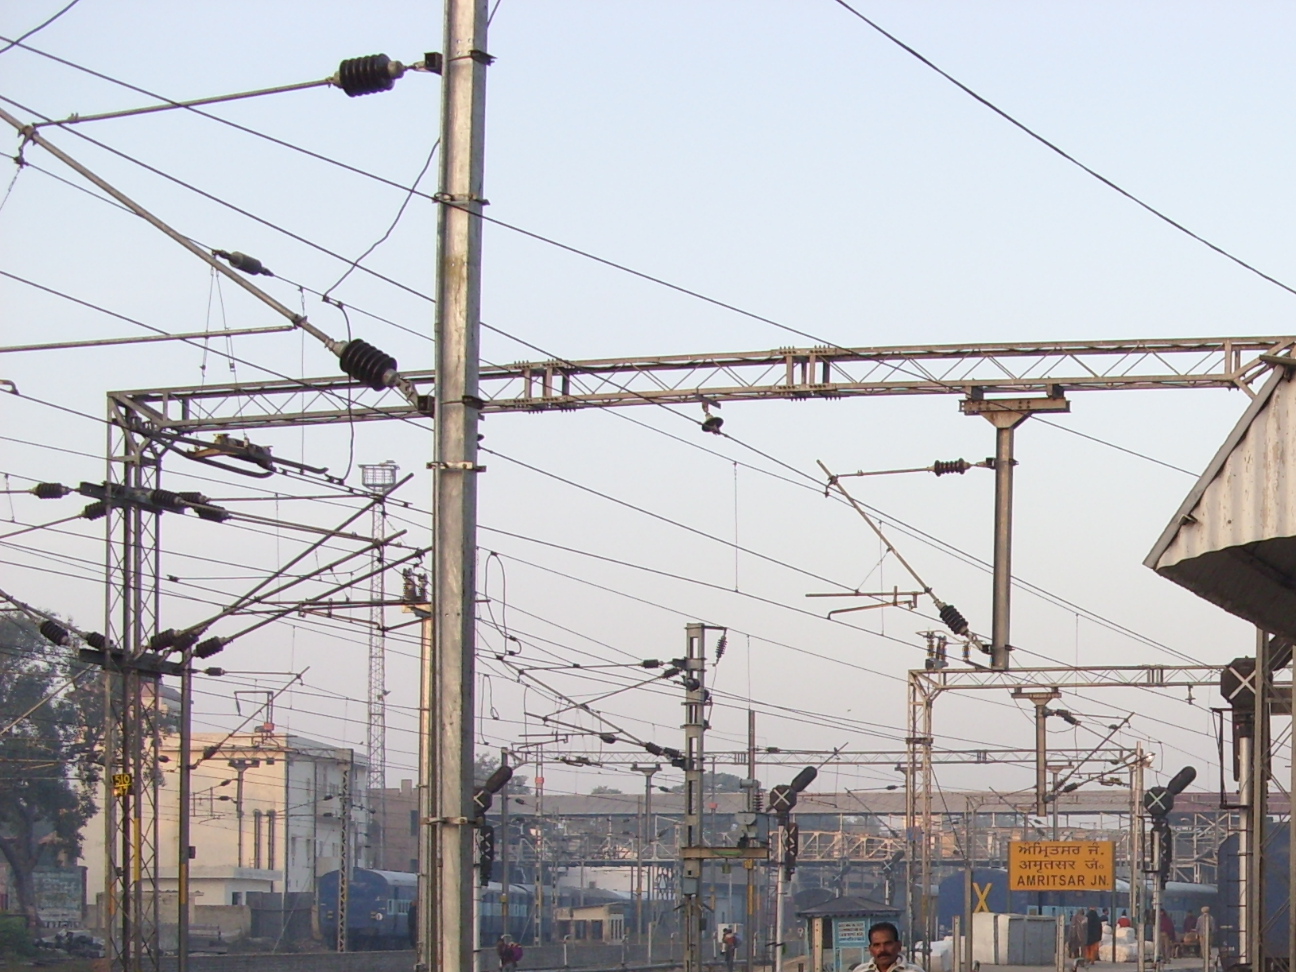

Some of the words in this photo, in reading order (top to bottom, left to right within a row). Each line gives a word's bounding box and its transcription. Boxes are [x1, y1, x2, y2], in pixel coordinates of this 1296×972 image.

[1019, 860, 1076, 873] अमृतसर
[1017, 875, 1085, 886] AMRITSAR
[1091, 875, 1109, 886] JN.
